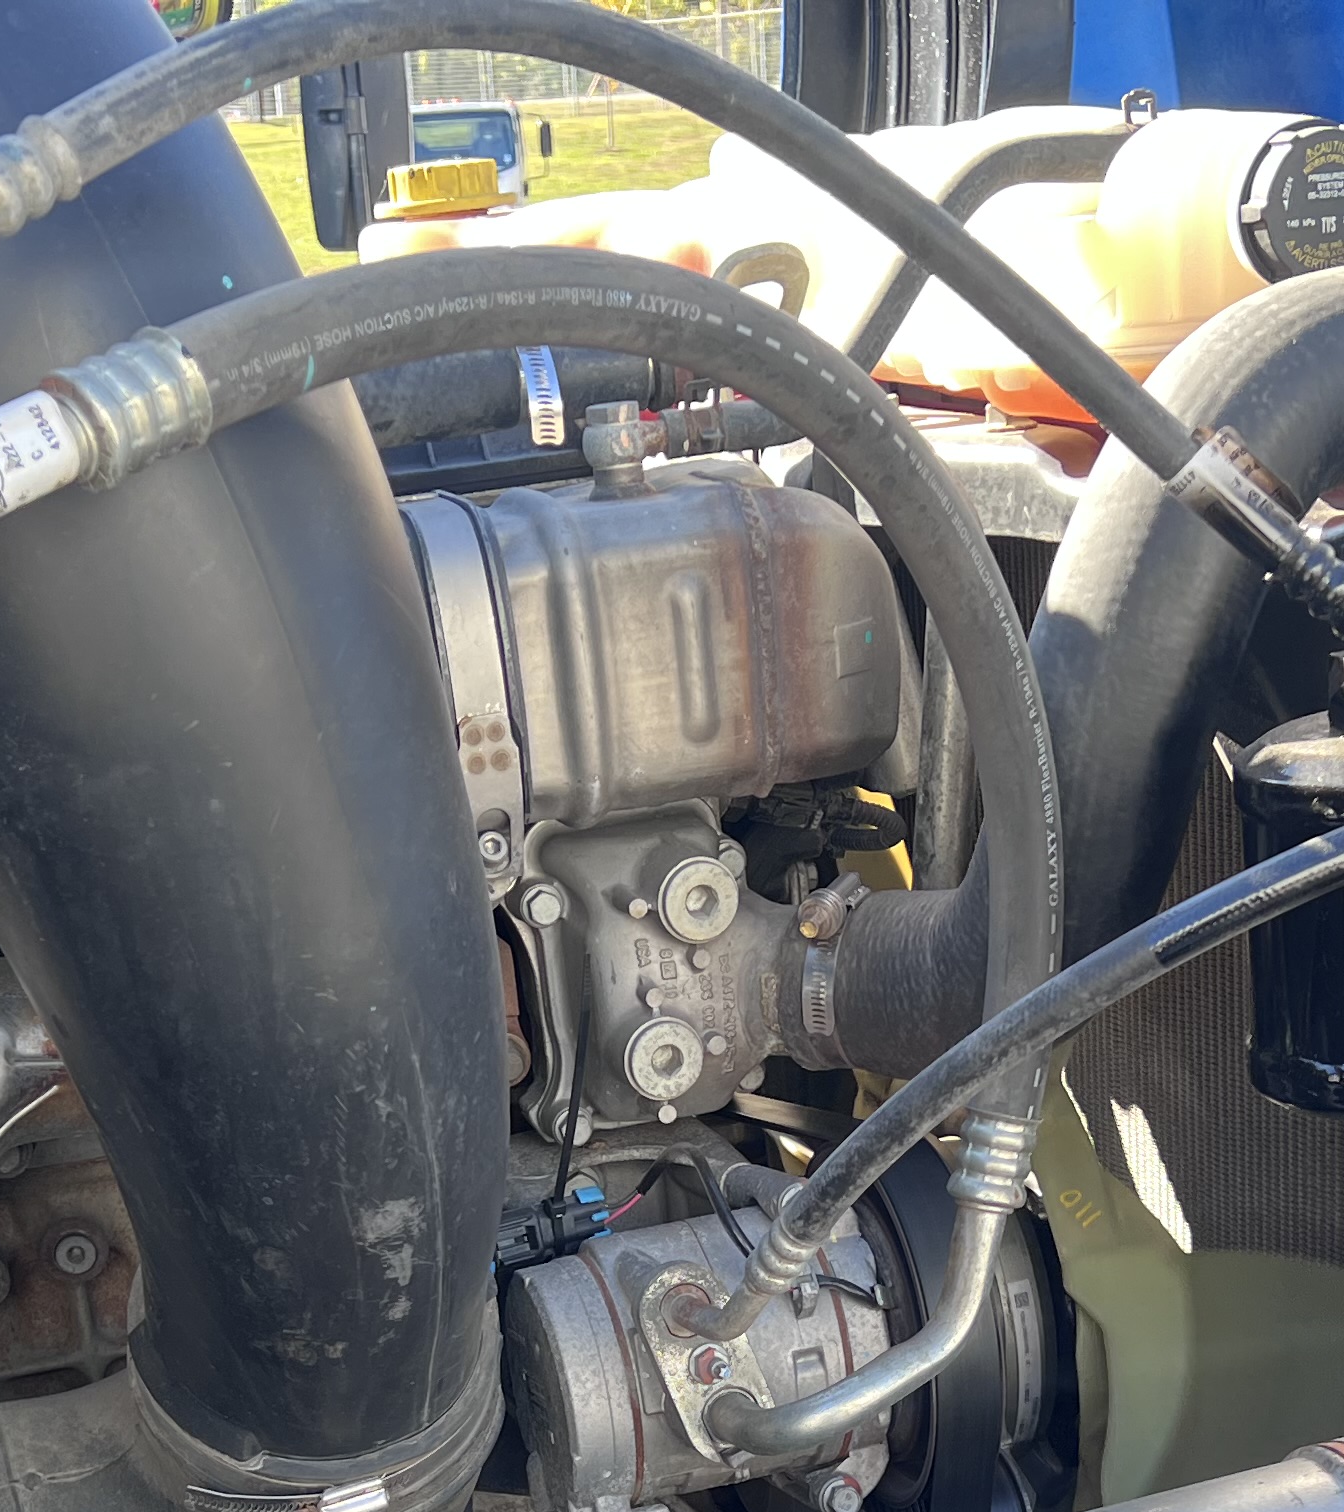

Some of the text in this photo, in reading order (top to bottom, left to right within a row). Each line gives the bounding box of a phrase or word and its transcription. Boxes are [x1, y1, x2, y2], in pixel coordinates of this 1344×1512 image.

[541, 287, 603, 306] FlexBarrier
[606, 289, 633, 309] 4880
[636, 292, 701, 322] GALAXY
[355, 308, 411, 338] SUCTION
[415, 303, 436, 322] A/C
[315, 326, 352, 351] HOSE
[951, 515, 973, 552] HOSE
[969, 545, 999, 599] SUCTION
[1033, 721, 1053, 793] FlexBarrier
[1043, 793, 1055, 824] 4880
[1047, 829, 1058, 907] GALAXY
[633, 938, 652, 968] USA
